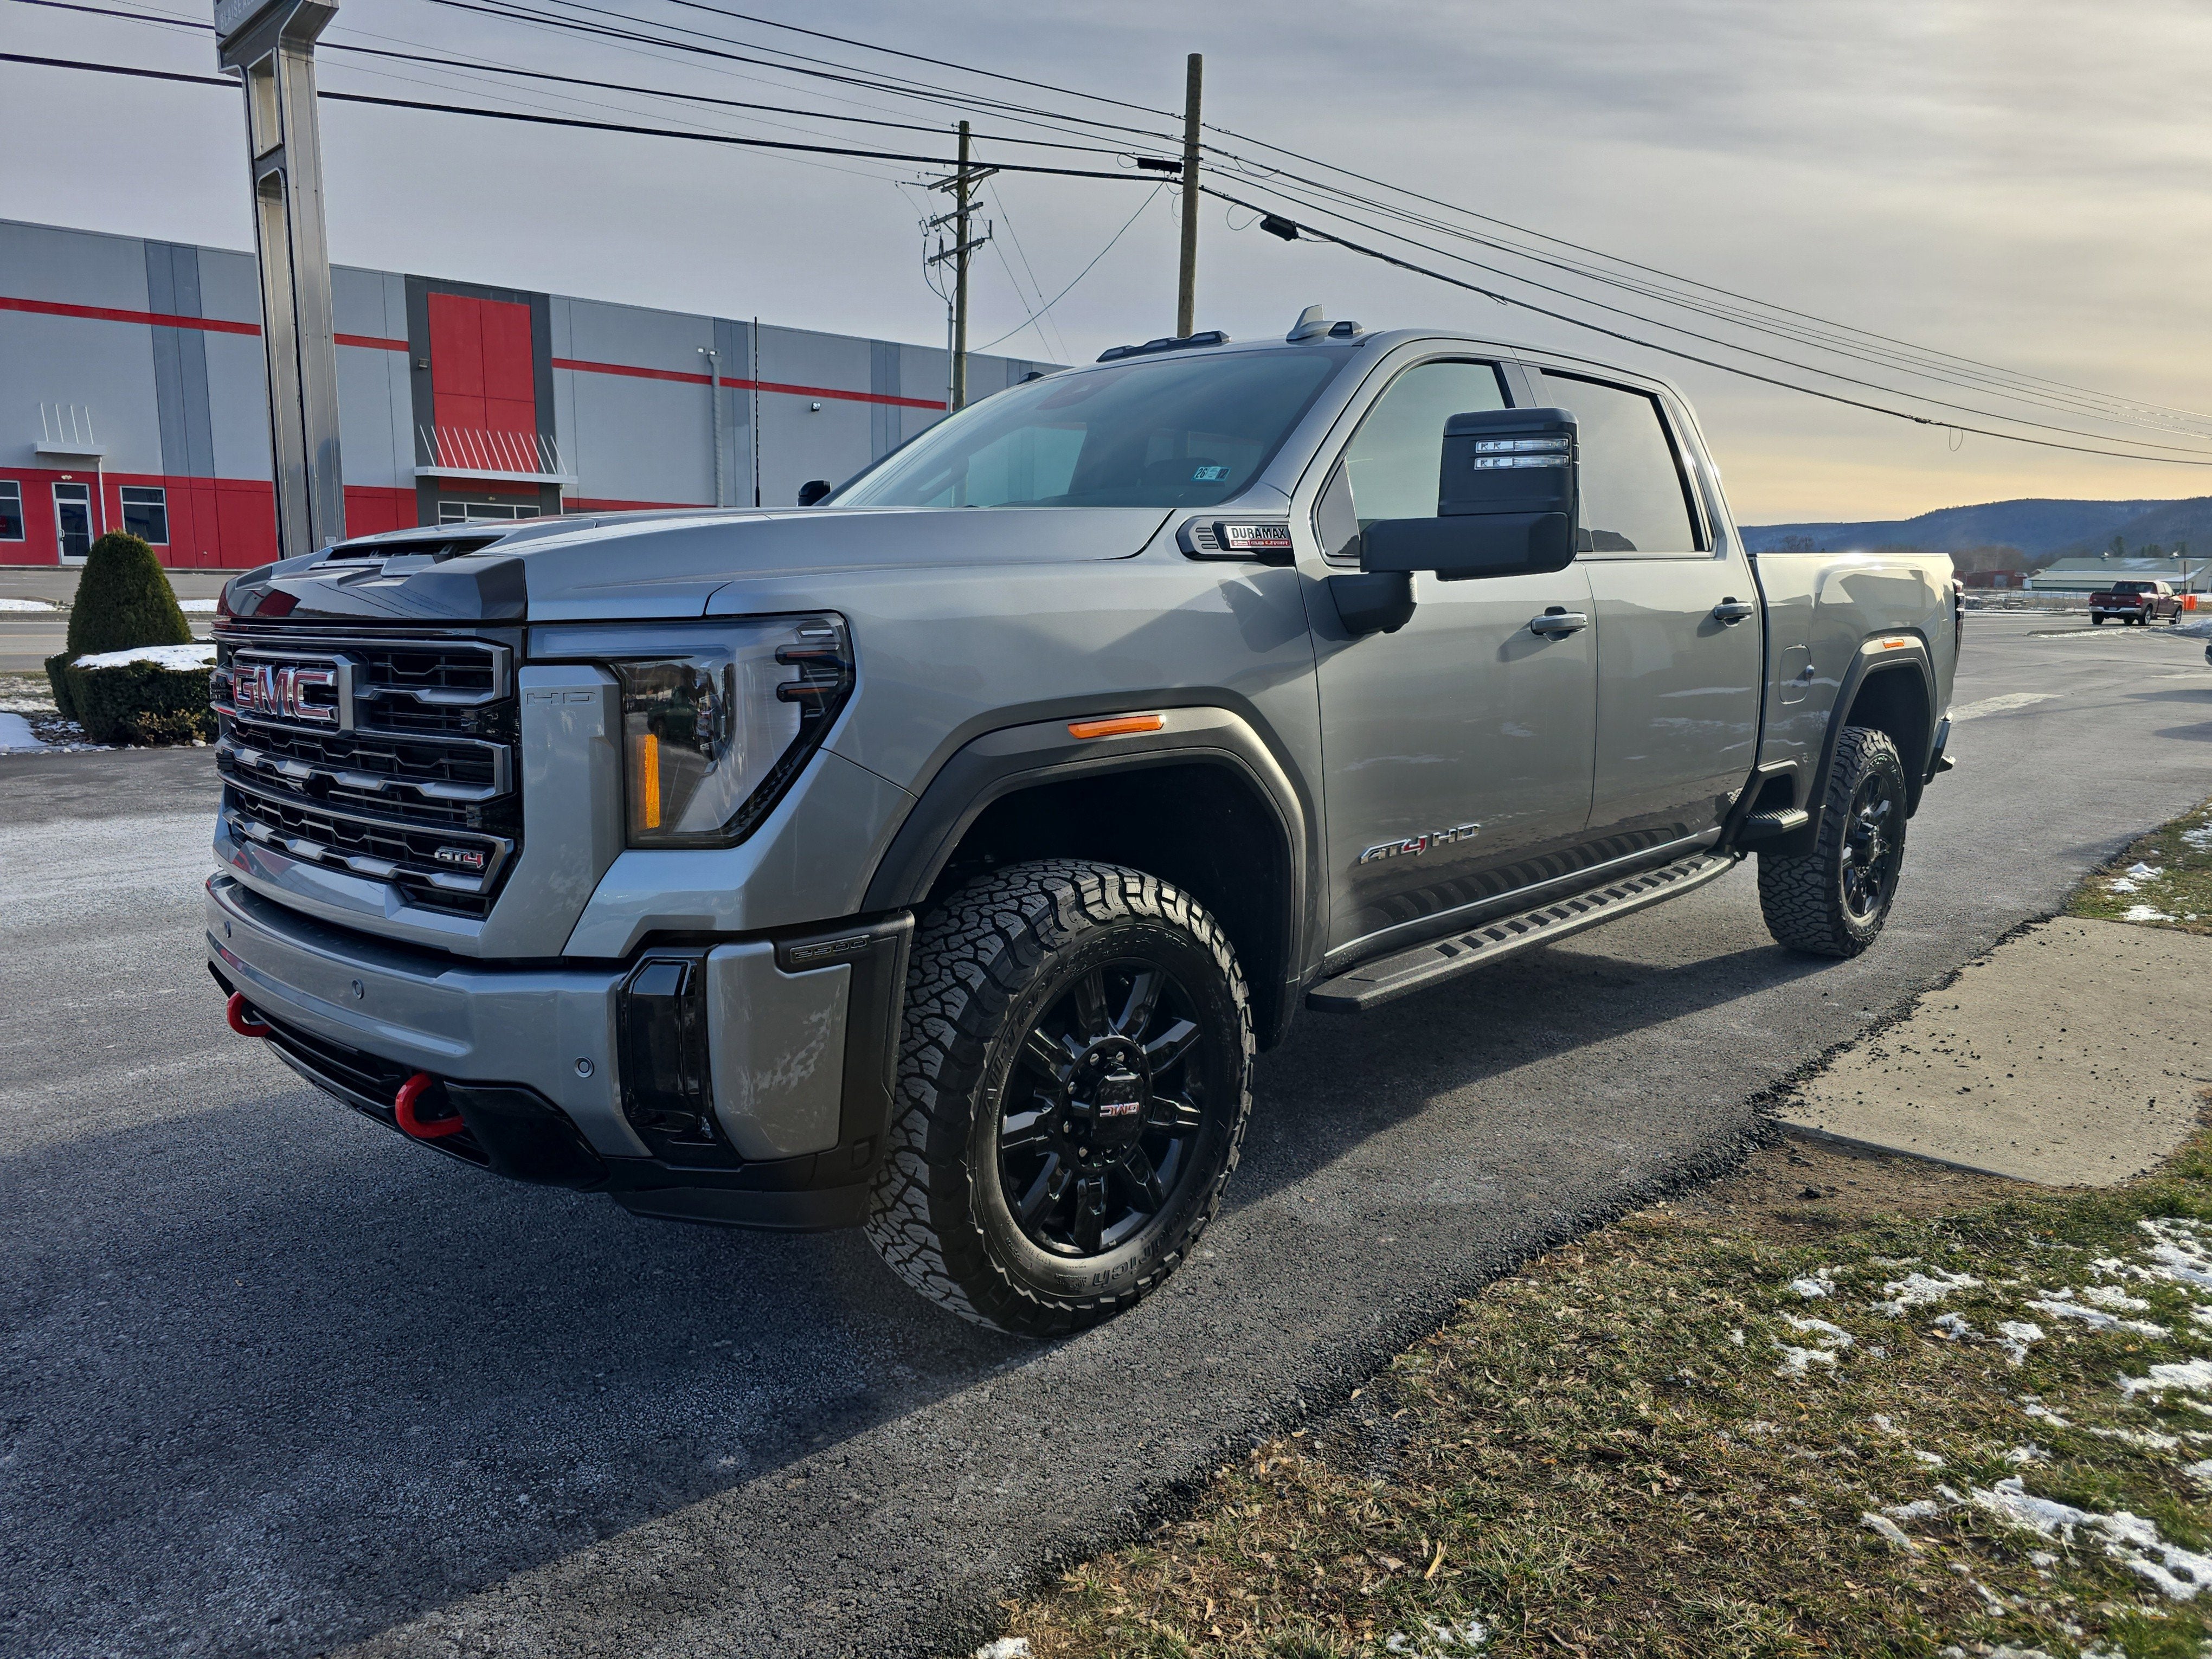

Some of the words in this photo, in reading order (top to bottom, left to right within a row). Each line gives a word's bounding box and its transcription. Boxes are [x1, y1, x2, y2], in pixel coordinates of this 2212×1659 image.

[1195, 467, 1208, 478] 26
[1231, 528, 1287, 539] DURAMAX
[232, 664, 338, 721] GMC
[526, 691, 596, 706] HD
[1360, 834, 1428, 864] AT4
[1431, 823, 1481, 847] HD
[434, 846, 484, 869] AT4
[795, 939, 867, 959] 2500
[1099, 1102, 1139, 1117] GMC
